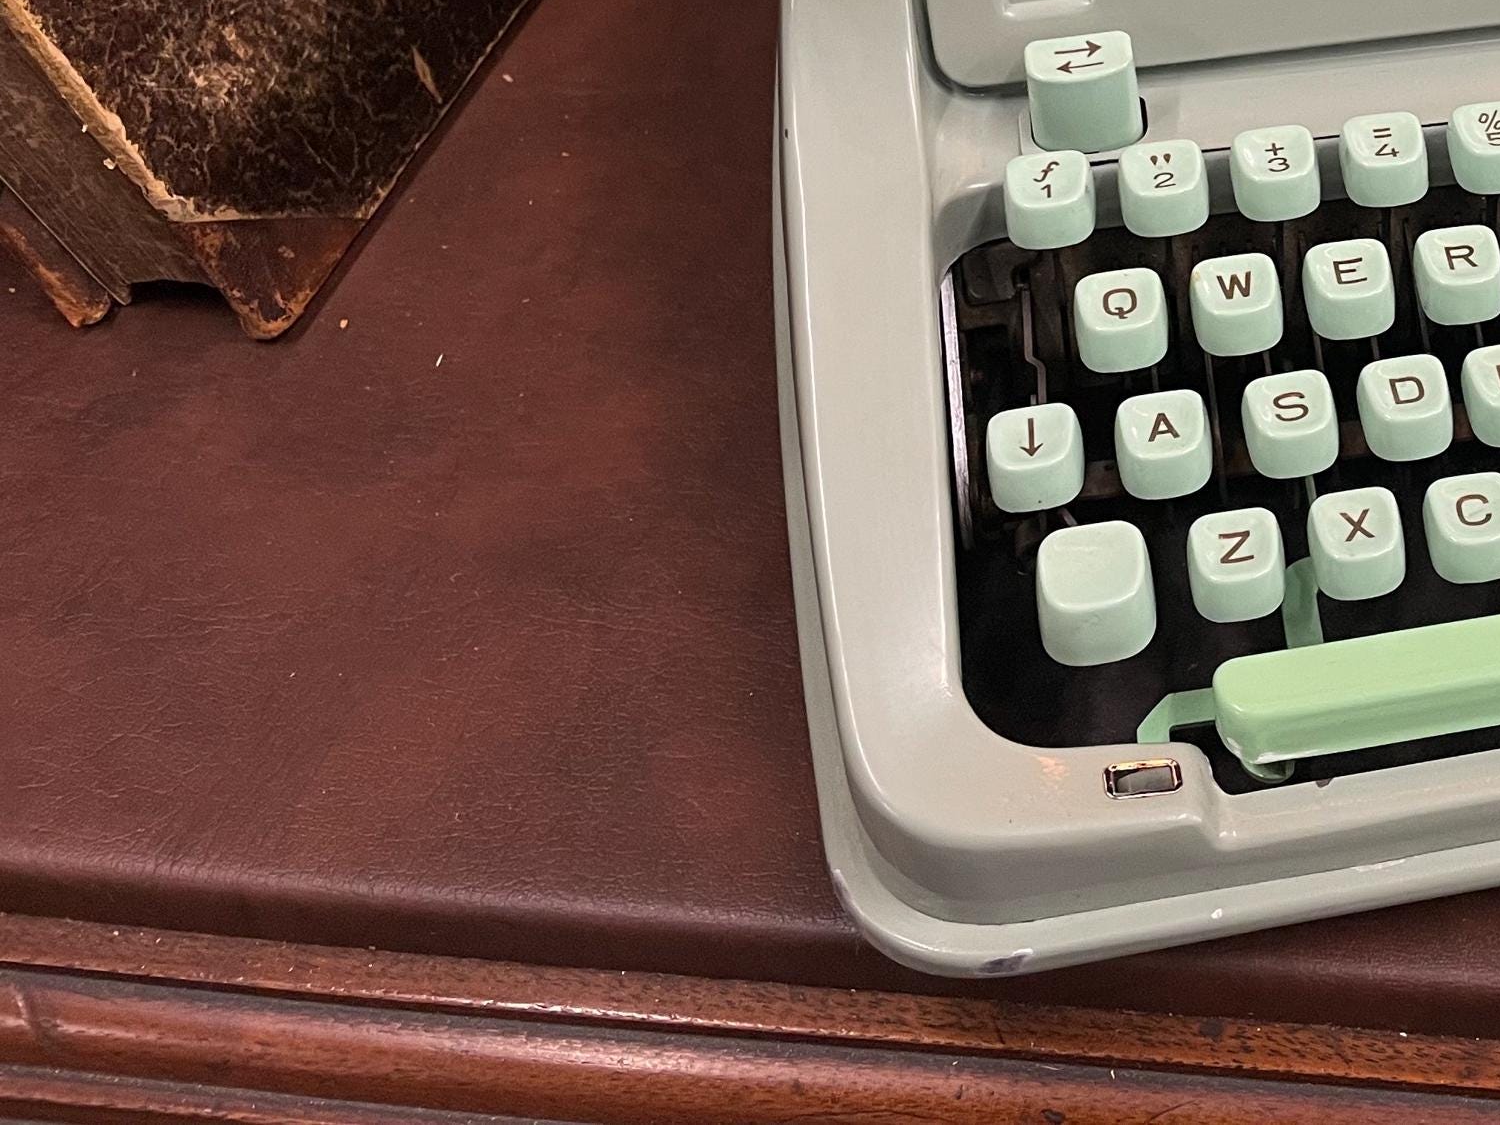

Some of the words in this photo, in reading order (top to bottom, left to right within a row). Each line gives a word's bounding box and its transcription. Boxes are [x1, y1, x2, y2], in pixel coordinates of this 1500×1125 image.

[1267, 157, 1290, 173] 3
[1374, 143, 1400, 158] 4
[1041, 184, 1052, 199] 1
[1153, 172, 1177, 189] 2
[1332, 257, 1368, 285] E
[1444, 244, 1478, 271] R
[1216, 271, 1252, 300] W
[1102, 288, 1138, 320] Q
[1388, 376, 1425, 405] D
[1272, 391, 1309, 422] S
[1148, 412, 1180, 443] A
[1339, 508, 1376, 542] X
[1455, 494, 1493, 527] C
[1218, 530, 1255, 564] Z
